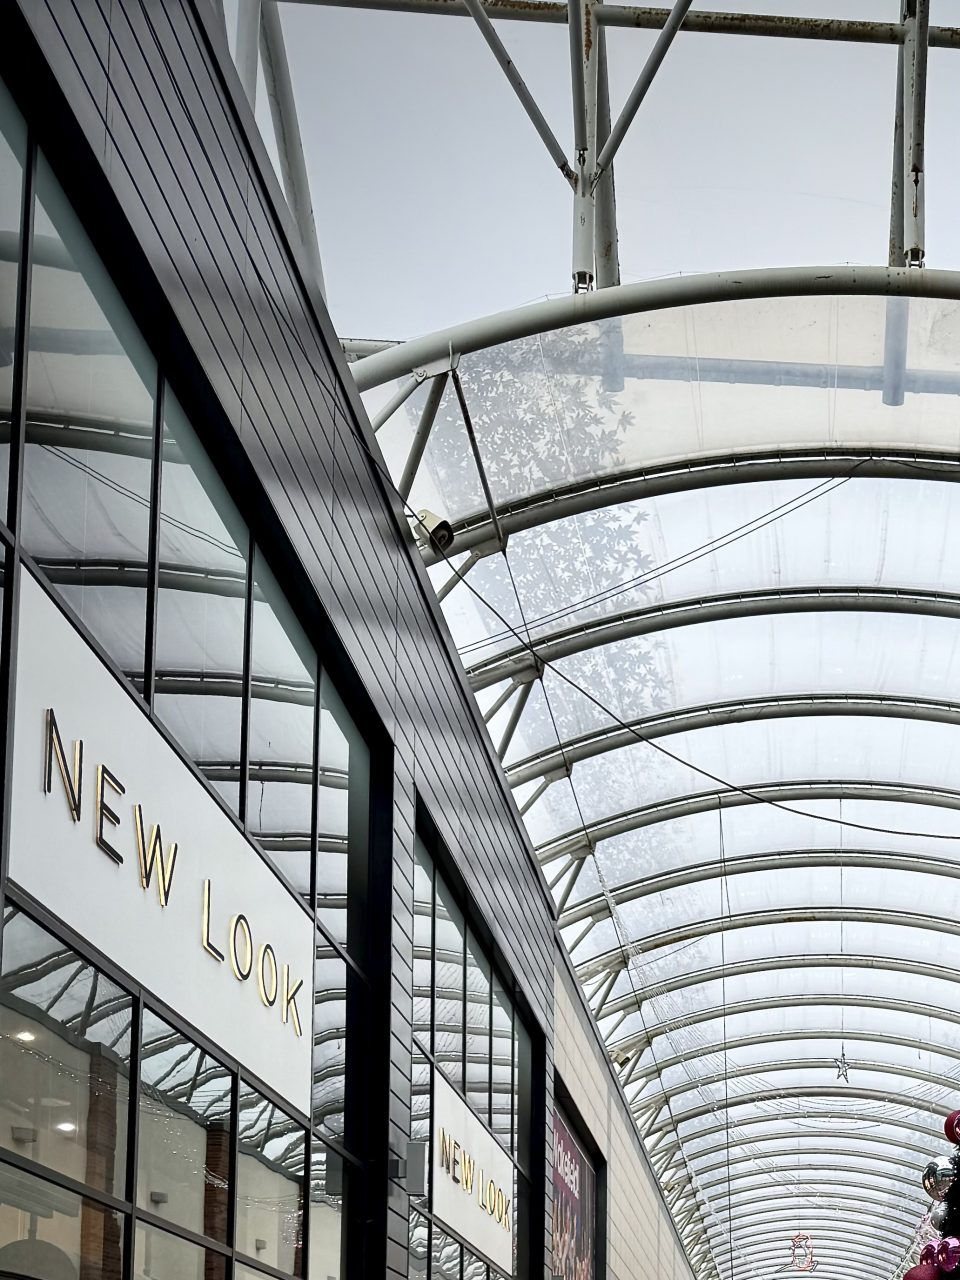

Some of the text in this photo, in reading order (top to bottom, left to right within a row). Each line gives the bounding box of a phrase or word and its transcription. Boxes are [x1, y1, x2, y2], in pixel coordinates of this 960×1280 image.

[44, 707, 304, 1038] NEW LOOK
[439, 1127, 511, 1233] NEW LOOK
